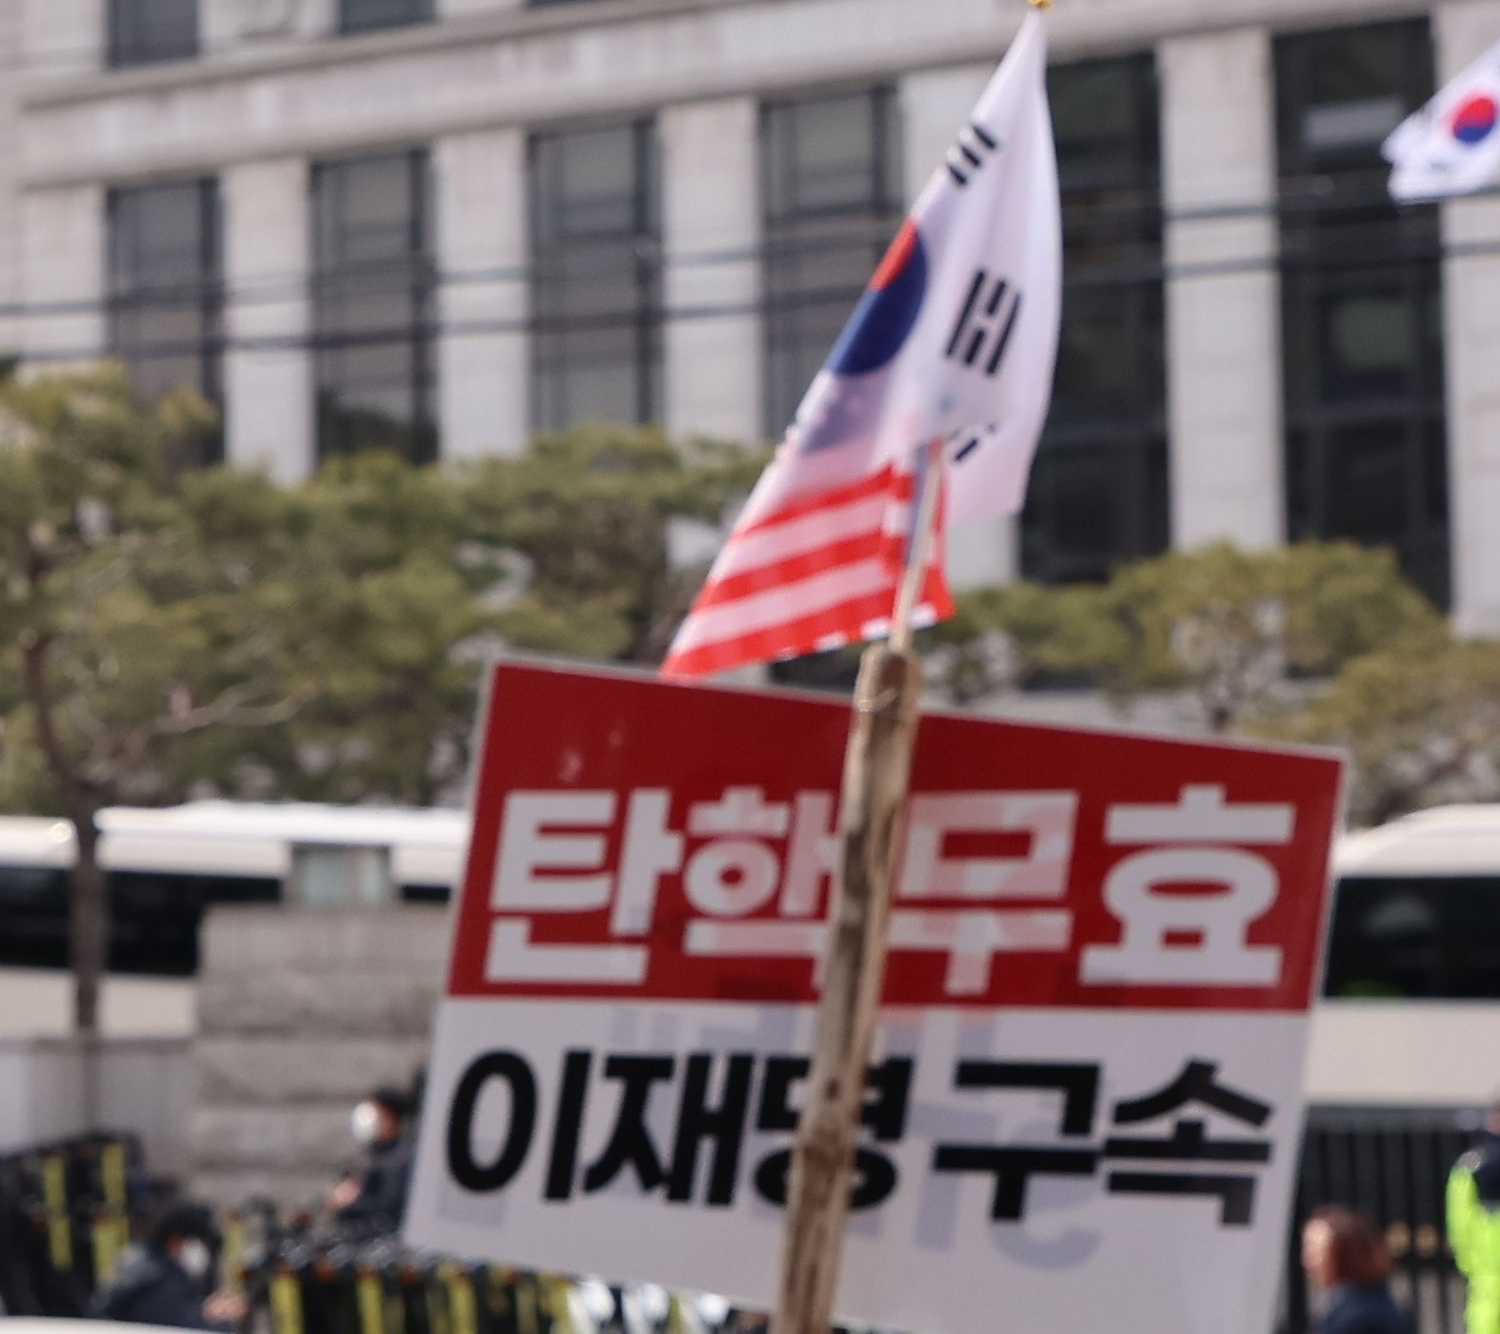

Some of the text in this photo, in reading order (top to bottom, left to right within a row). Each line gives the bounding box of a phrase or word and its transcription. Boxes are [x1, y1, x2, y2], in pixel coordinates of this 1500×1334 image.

[485, 784, 1295, 995] 탄핵무효
[446, 1049, 1272, 1228] 이재명 구속
